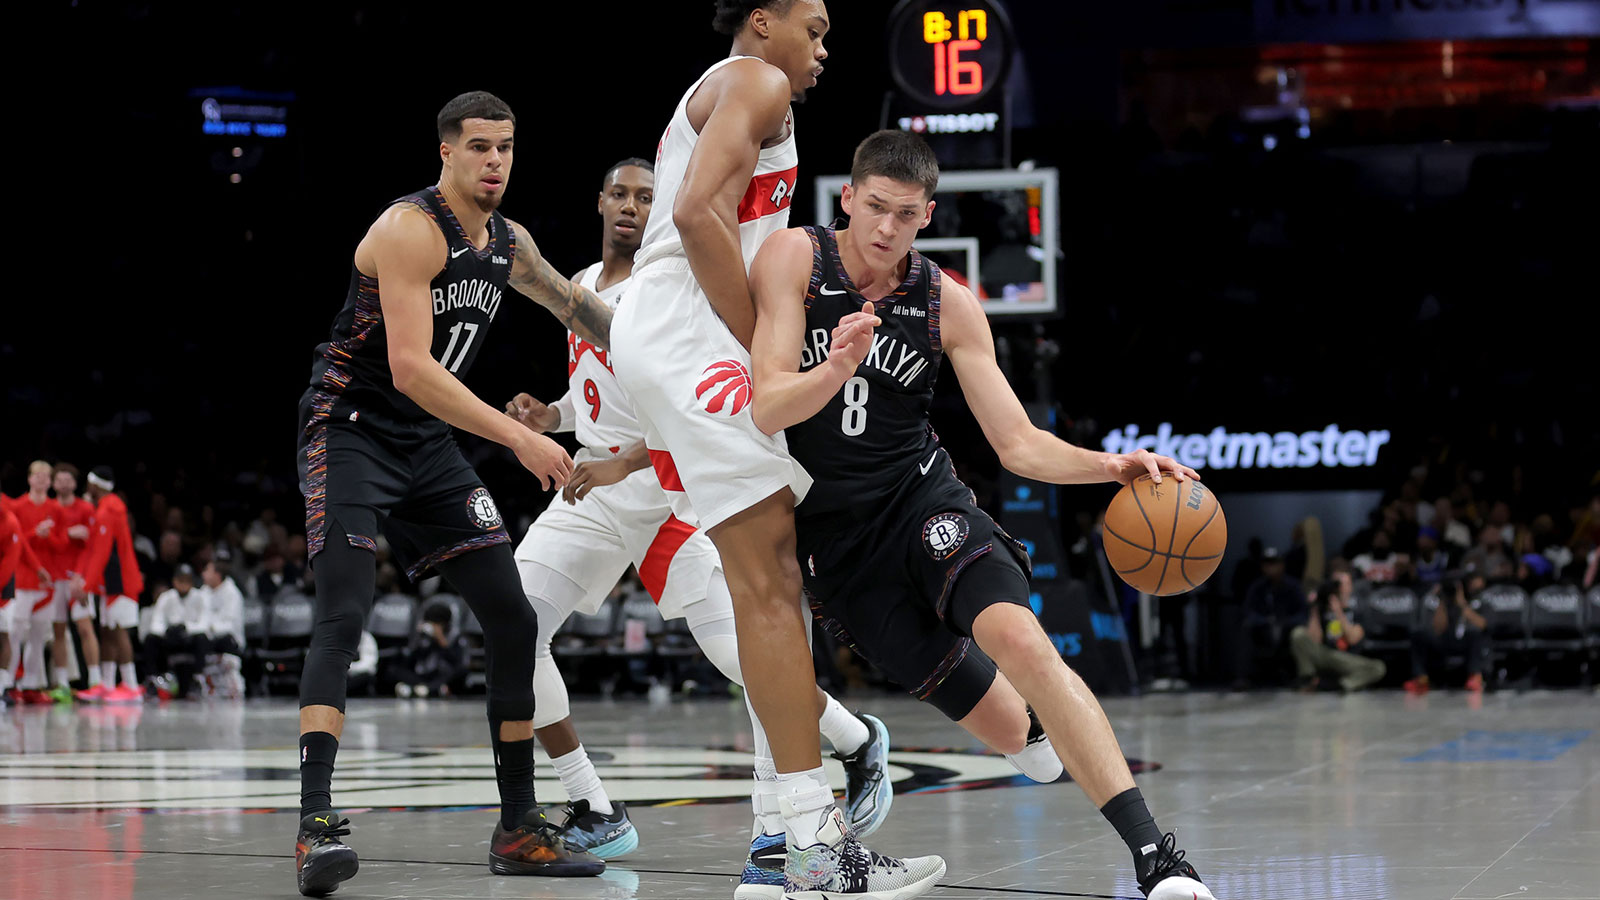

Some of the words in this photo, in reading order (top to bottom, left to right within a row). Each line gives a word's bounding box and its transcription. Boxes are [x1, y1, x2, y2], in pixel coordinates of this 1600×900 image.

[923, 9, 987, 43] 8:17
[934, 39, 983, 96] 16
[926, 113, 999, 133] TISSOT
[910, 306, 926, 318] Won
[439, 321, 479, 373] 17
[584, 378, 601, 424] 9
[841, 376, 869, 436] 8
[936, 525, 951, 546] B
